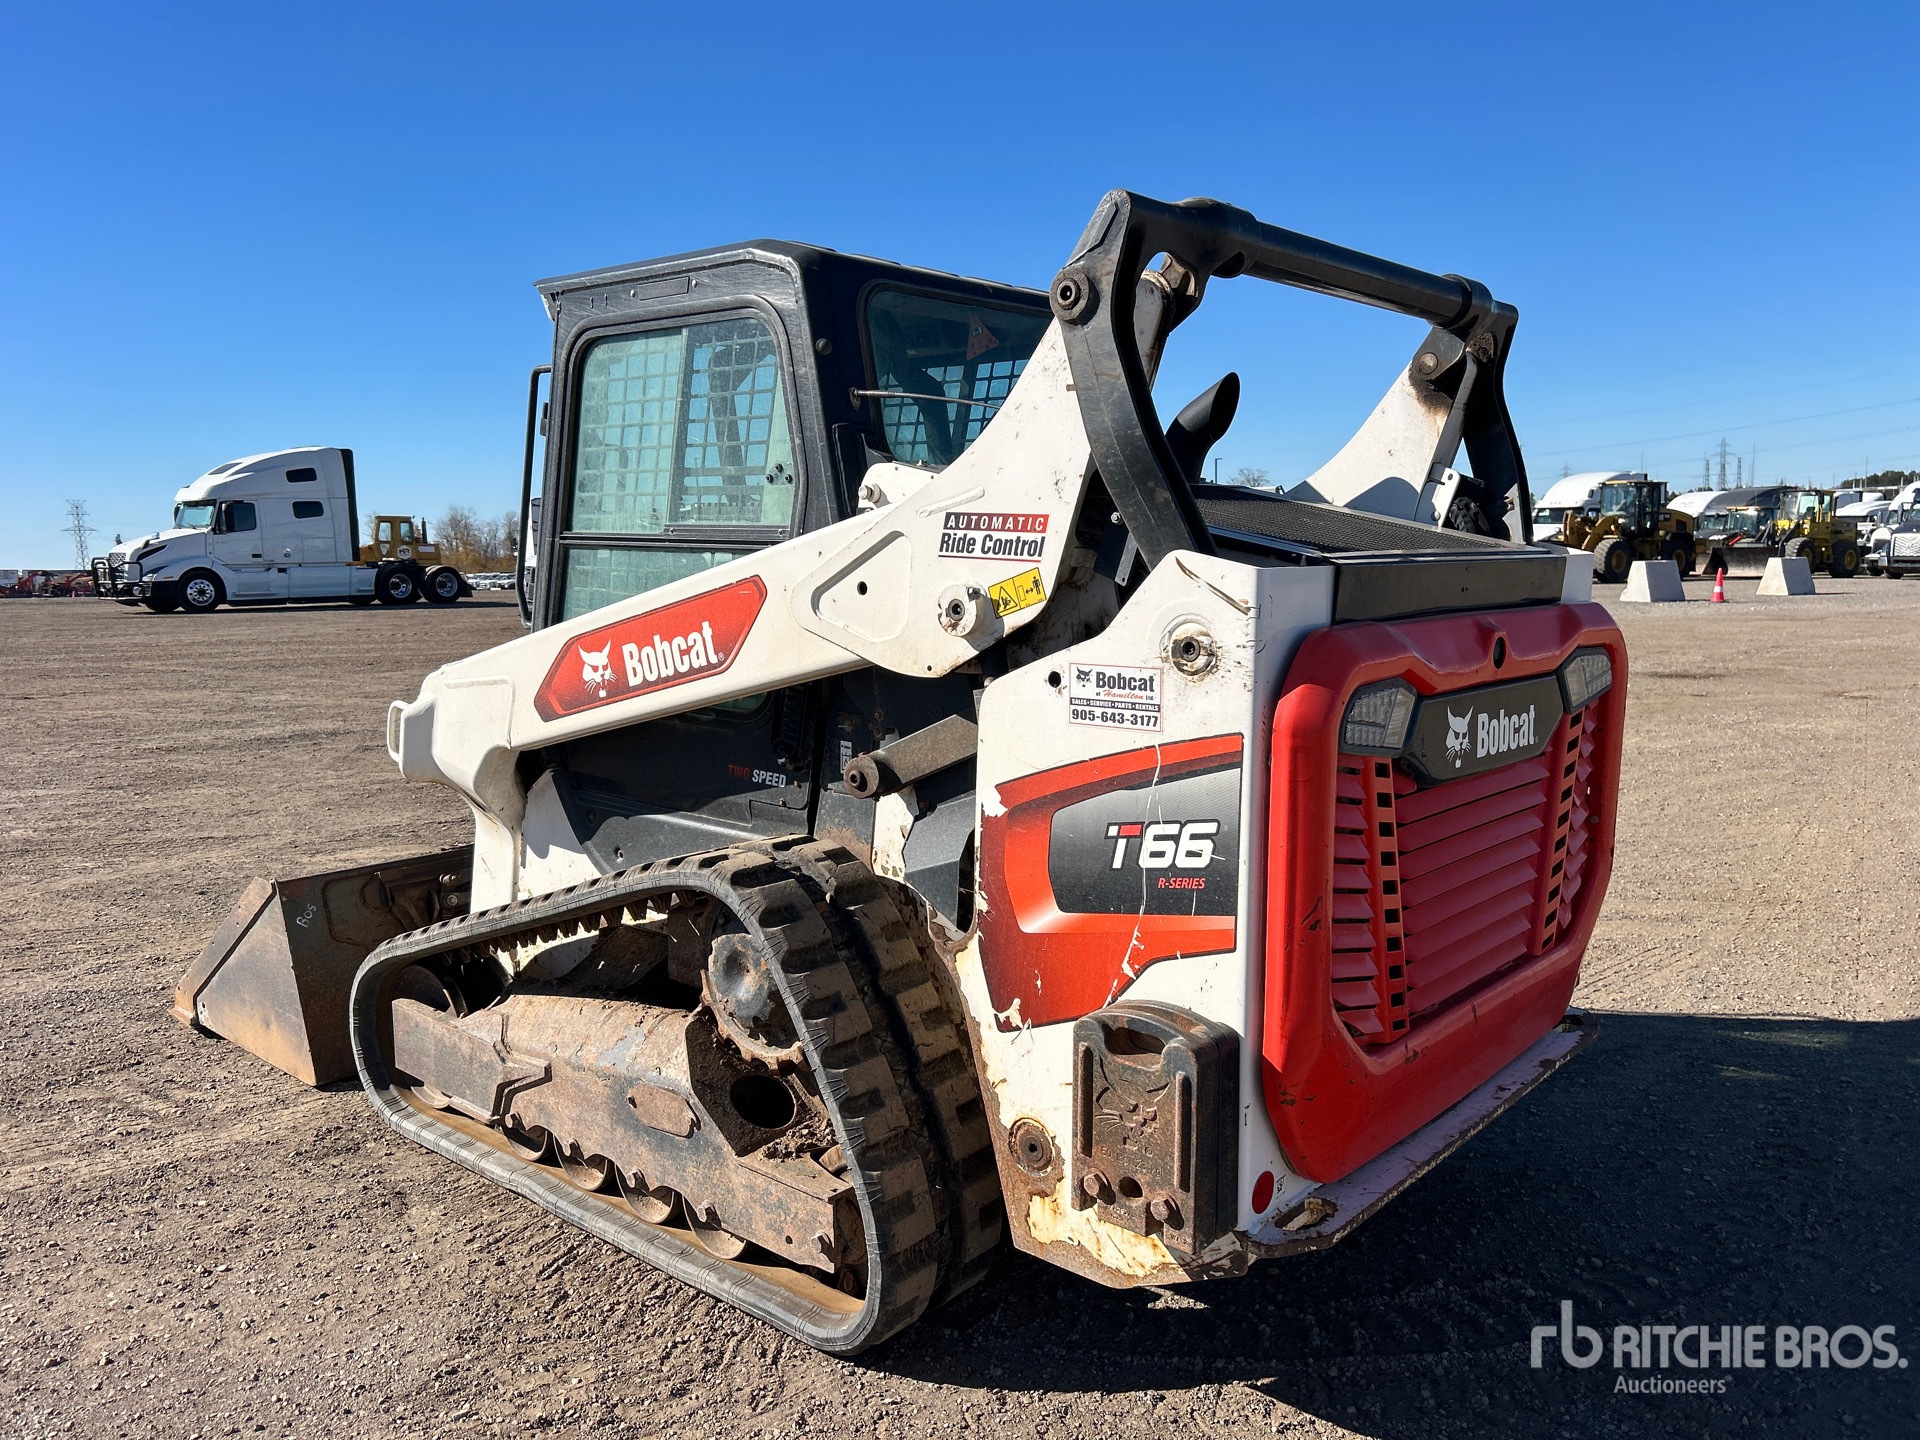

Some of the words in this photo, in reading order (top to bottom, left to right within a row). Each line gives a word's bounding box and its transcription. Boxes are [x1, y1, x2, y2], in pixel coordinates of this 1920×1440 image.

[947, 514, 1044, 532] AUTOMATIC
[939, 532, 977, 554] Ride
[981, 533, 1046, 558] Control
[621, 620, 719, 687] Bobcat
[1096, 672, 1155, 692] Bobcat
[1103, 689, 1144, 700] Hamilton
[1071, 709, 1158, 726] 905-643-3177
[1476, 704, 1536, 758] Bobcat
[727, 764, 751, 780] TWO
[752, 769, 787, 788] SPEED
[1106, 820, 1219, 870] T66
[1157, 877, 1206, 890] R-SERIES
